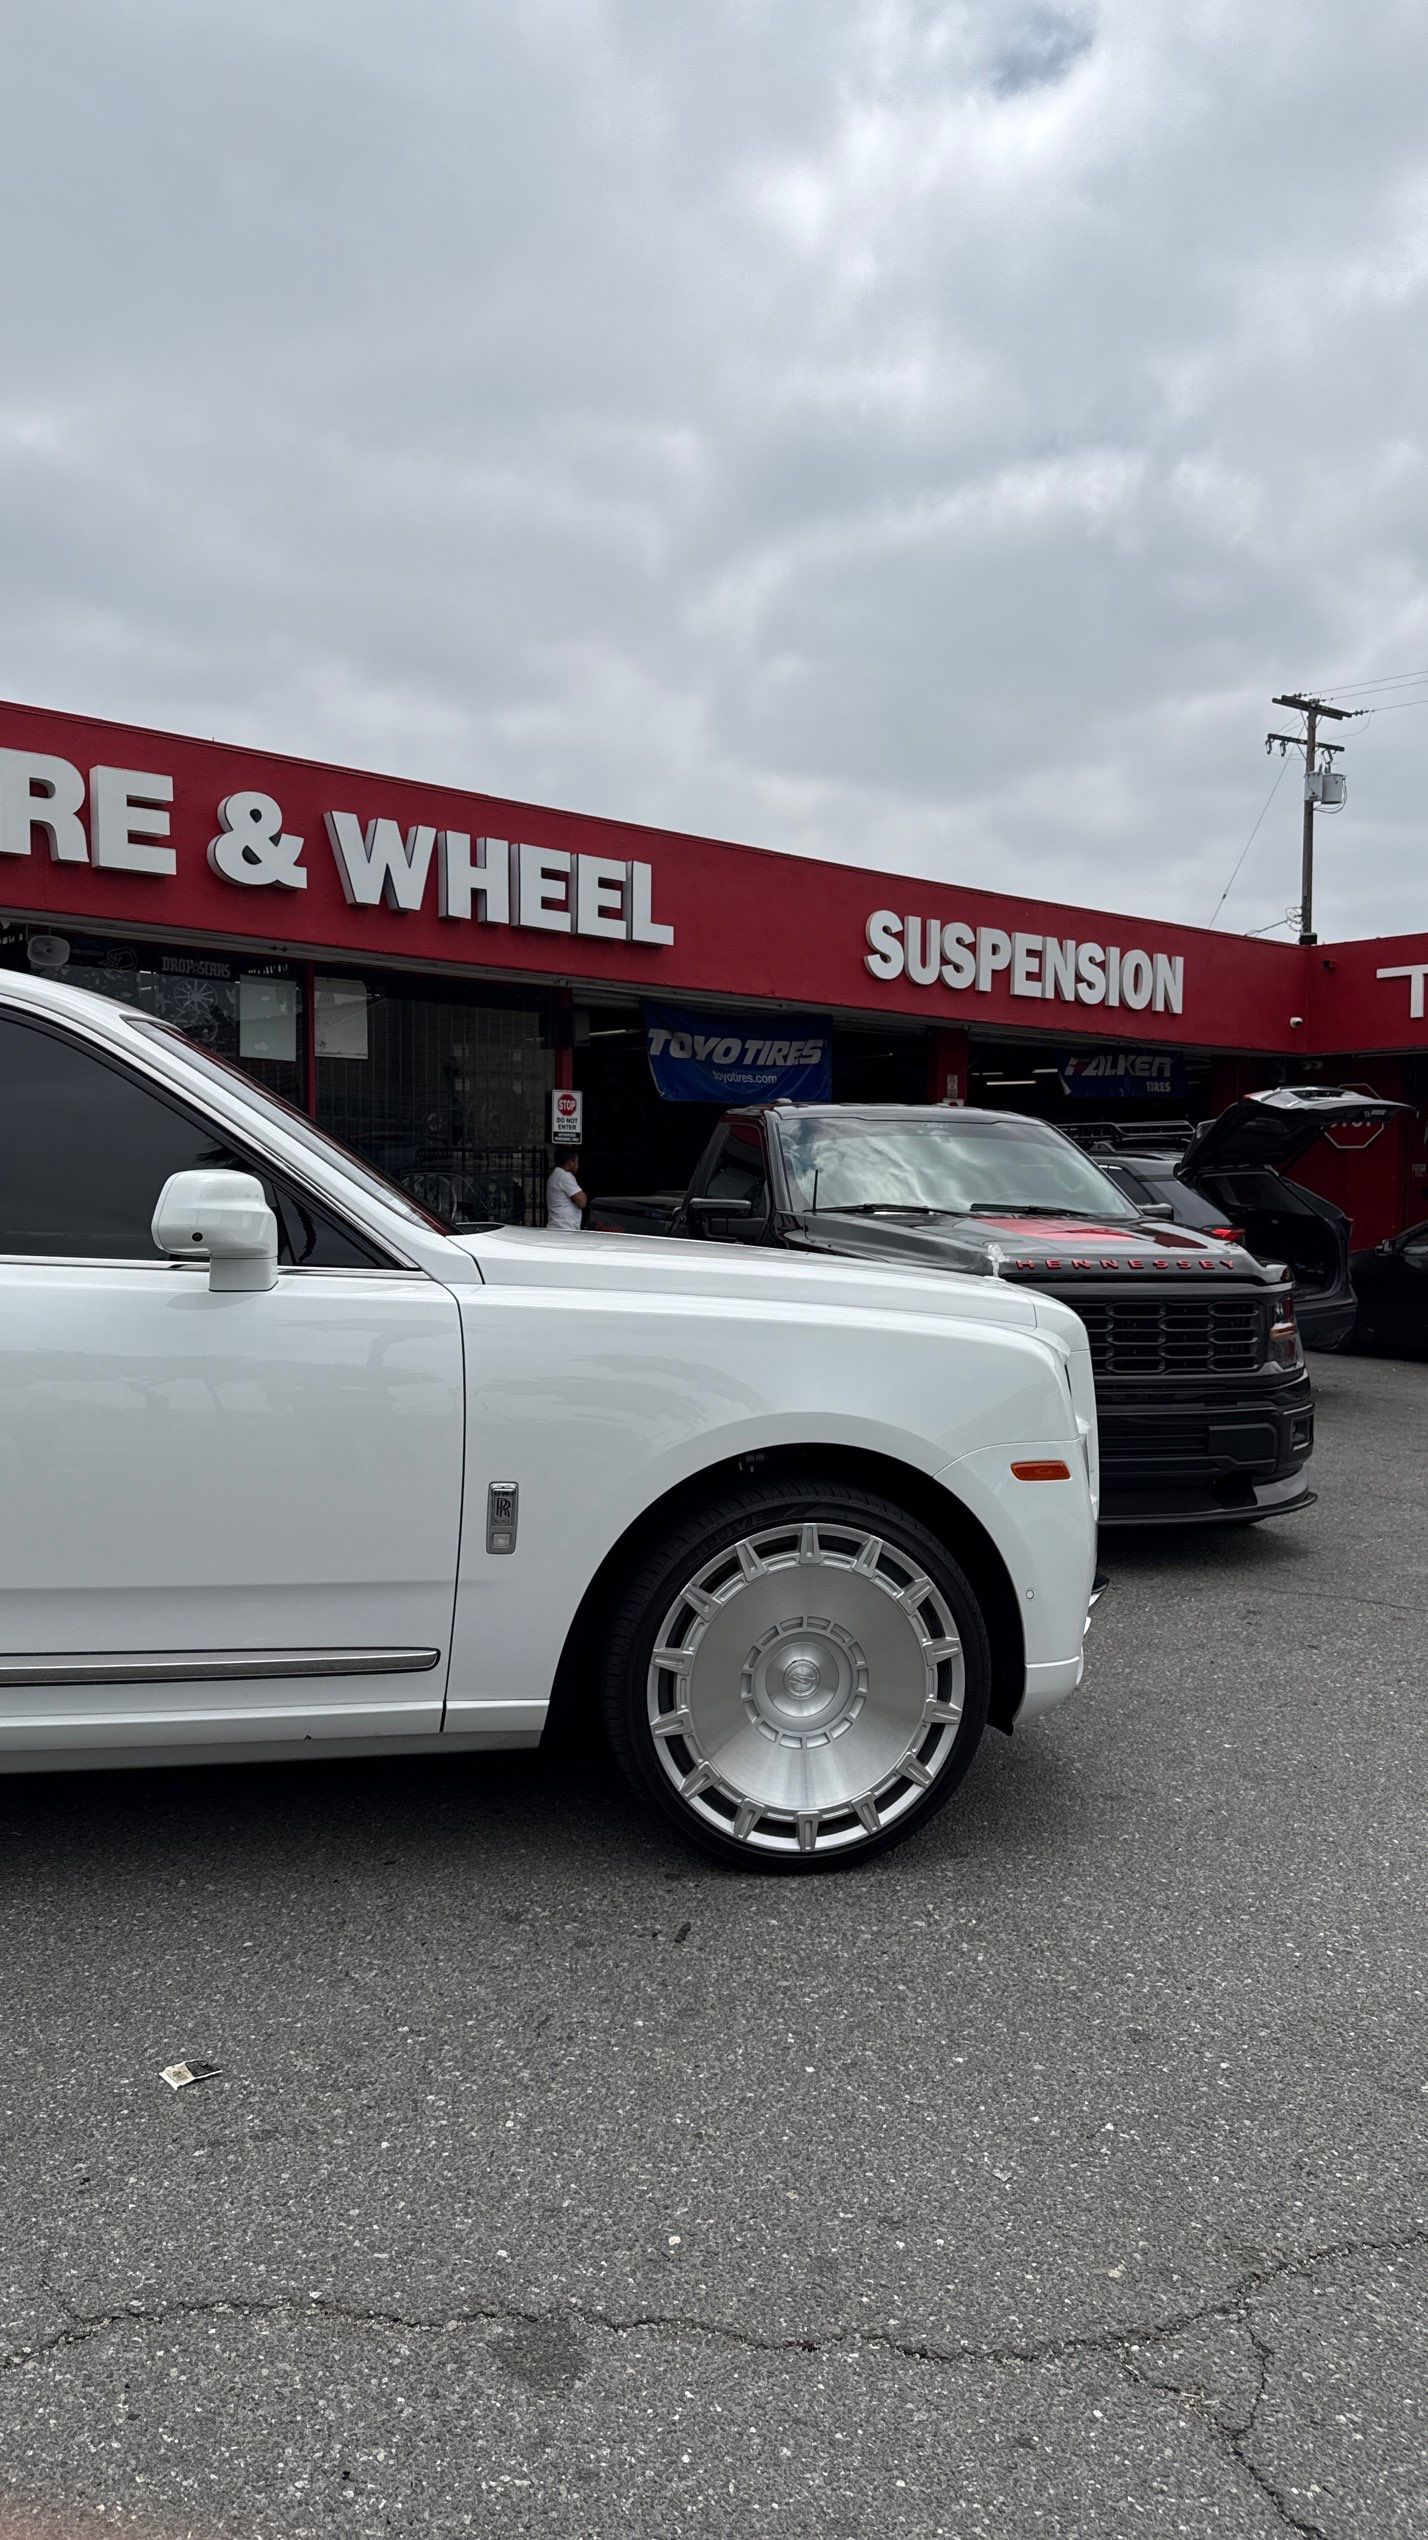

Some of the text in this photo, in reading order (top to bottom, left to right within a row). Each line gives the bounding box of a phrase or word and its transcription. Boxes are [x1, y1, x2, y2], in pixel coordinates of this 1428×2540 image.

[0, 748, 675, 946] RE & WHEEL
[864, 909, 1185, 1015] SUSPENSION
[1376, 964, 1428, 1018] T
[648, 1028, 823, 1066] TOYO TIRES
[713, 1069, 778, 1085] toyotires.com
[1064, 1054, 1177, 1078] FALKEN
[1146, 1081, 1171, 1093] TIRES
[558, 1099, 576, 1110] STOP
[1015, 1258, 1235, 1270] HENNESSEY
